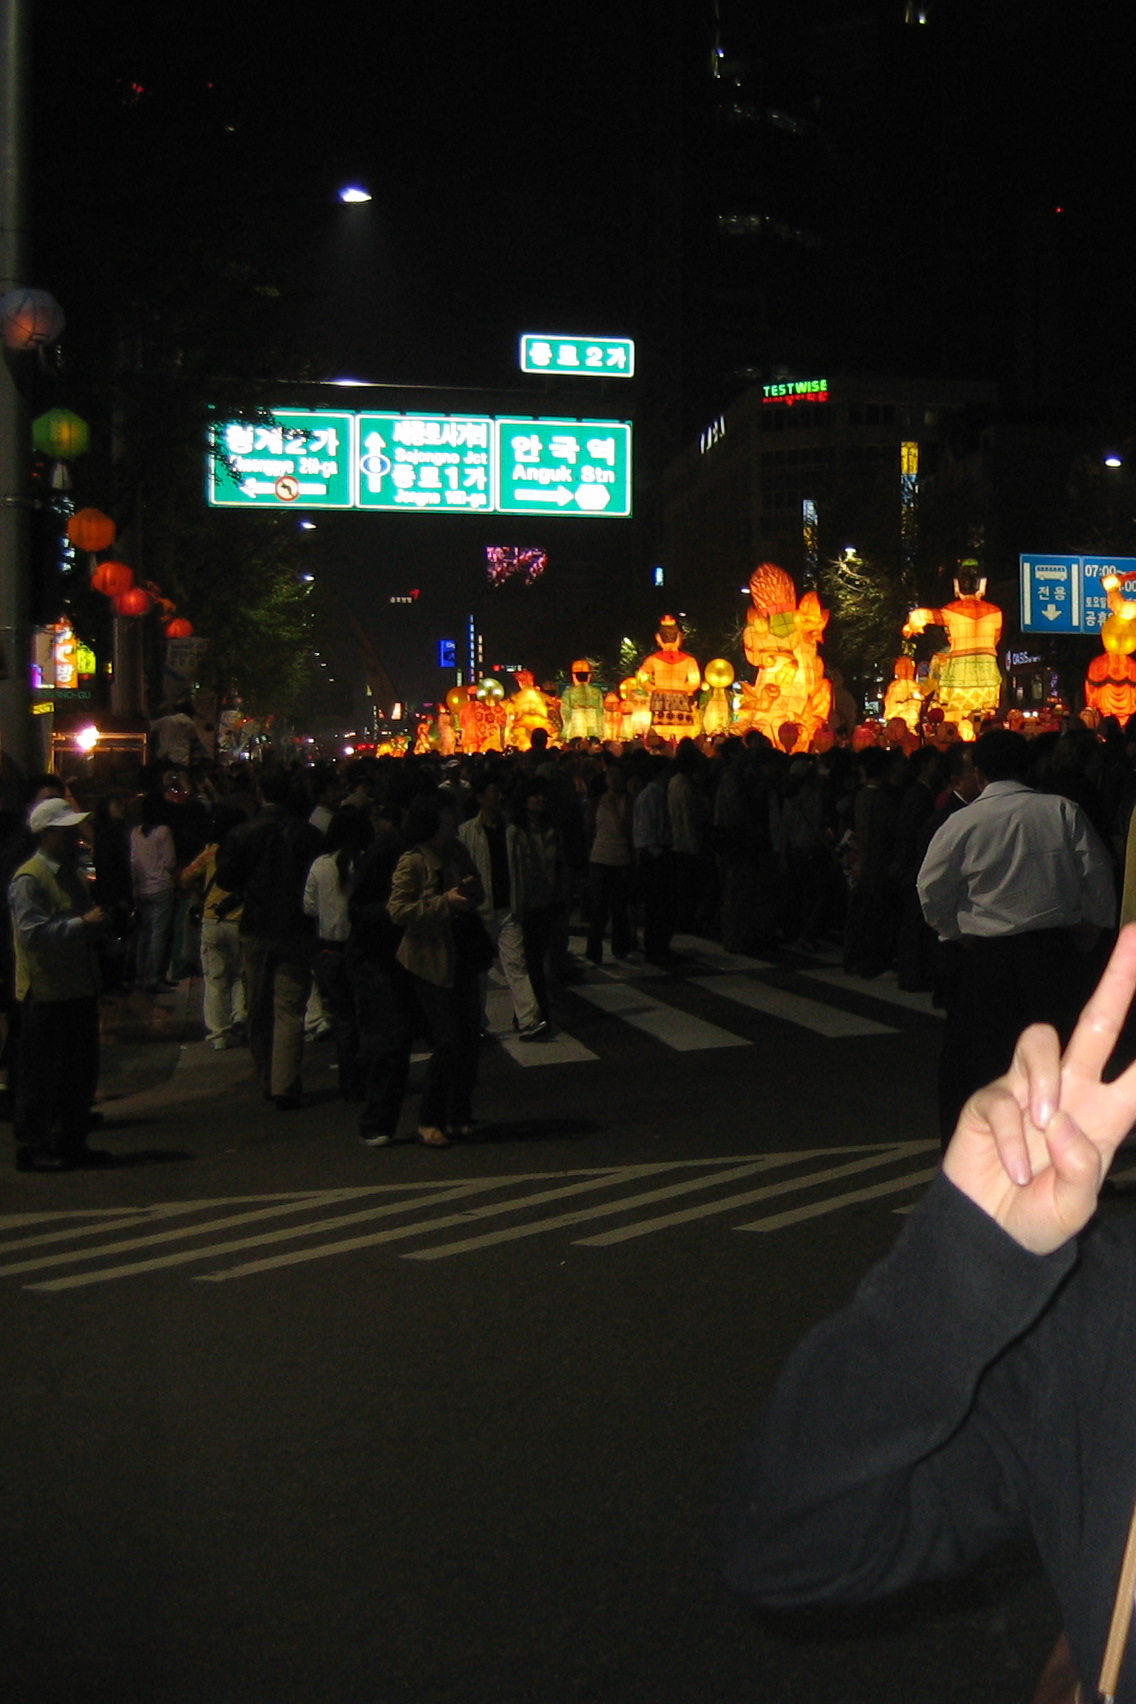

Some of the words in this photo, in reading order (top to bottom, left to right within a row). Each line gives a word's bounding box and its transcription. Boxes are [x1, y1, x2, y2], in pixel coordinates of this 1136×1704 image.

[529, 341, 628, 369] 종로2가
[762, 379, 828, 397] TESTWISE
[511, 434, 617, 466] 안국역
[391, 463, 488, 490] 종로1가
[512, 464, 573, 485] Anguk
[580, 465, 616, 484] Stn
[1037, 585, 1067, 601] 전용
[1085, 610, 1114, 627] 공휴
